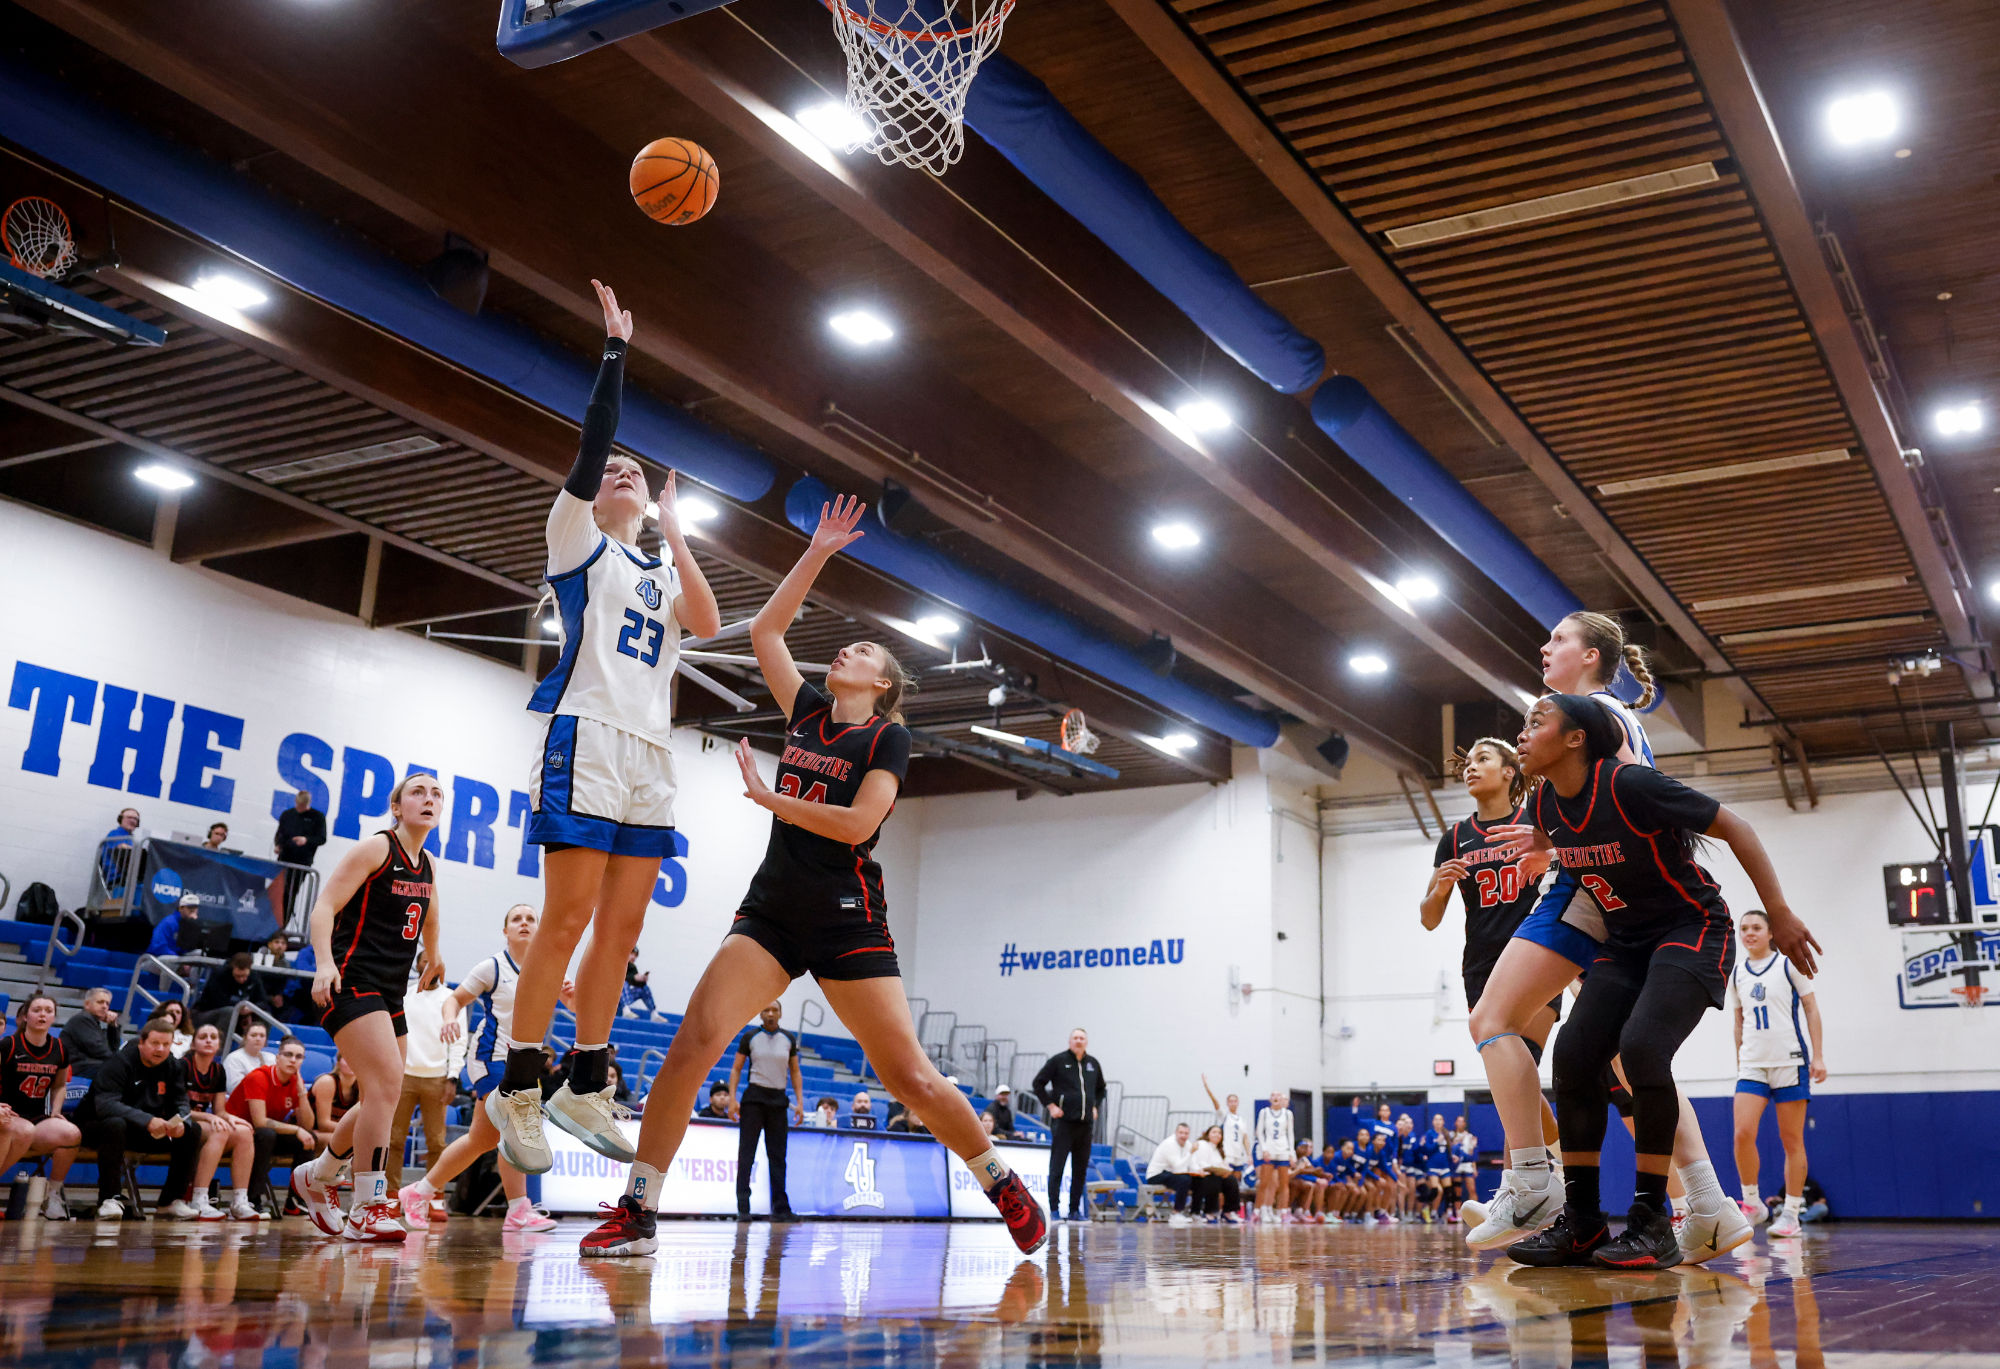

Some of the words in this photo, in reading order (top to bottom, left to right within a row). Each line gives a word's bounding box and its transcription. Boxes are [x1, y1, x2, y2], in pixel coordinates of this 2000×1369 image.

[617, 607, 665, 668] 23
[8, 660, 245, 814] THE
[781, 745, 853, 782] BENEDICTINE
[153, 883, 182, 898] NCAA
[1475, 865, 1520, 908] 20
[1581, 874, 1628, 912] 2
[401, 902, 422, 940] 3
[999, 938, 1185, 976] #weareoneAU
[1753, 1005, 1769, 1030] 11
[19, 1075, 51, 1098] 42
